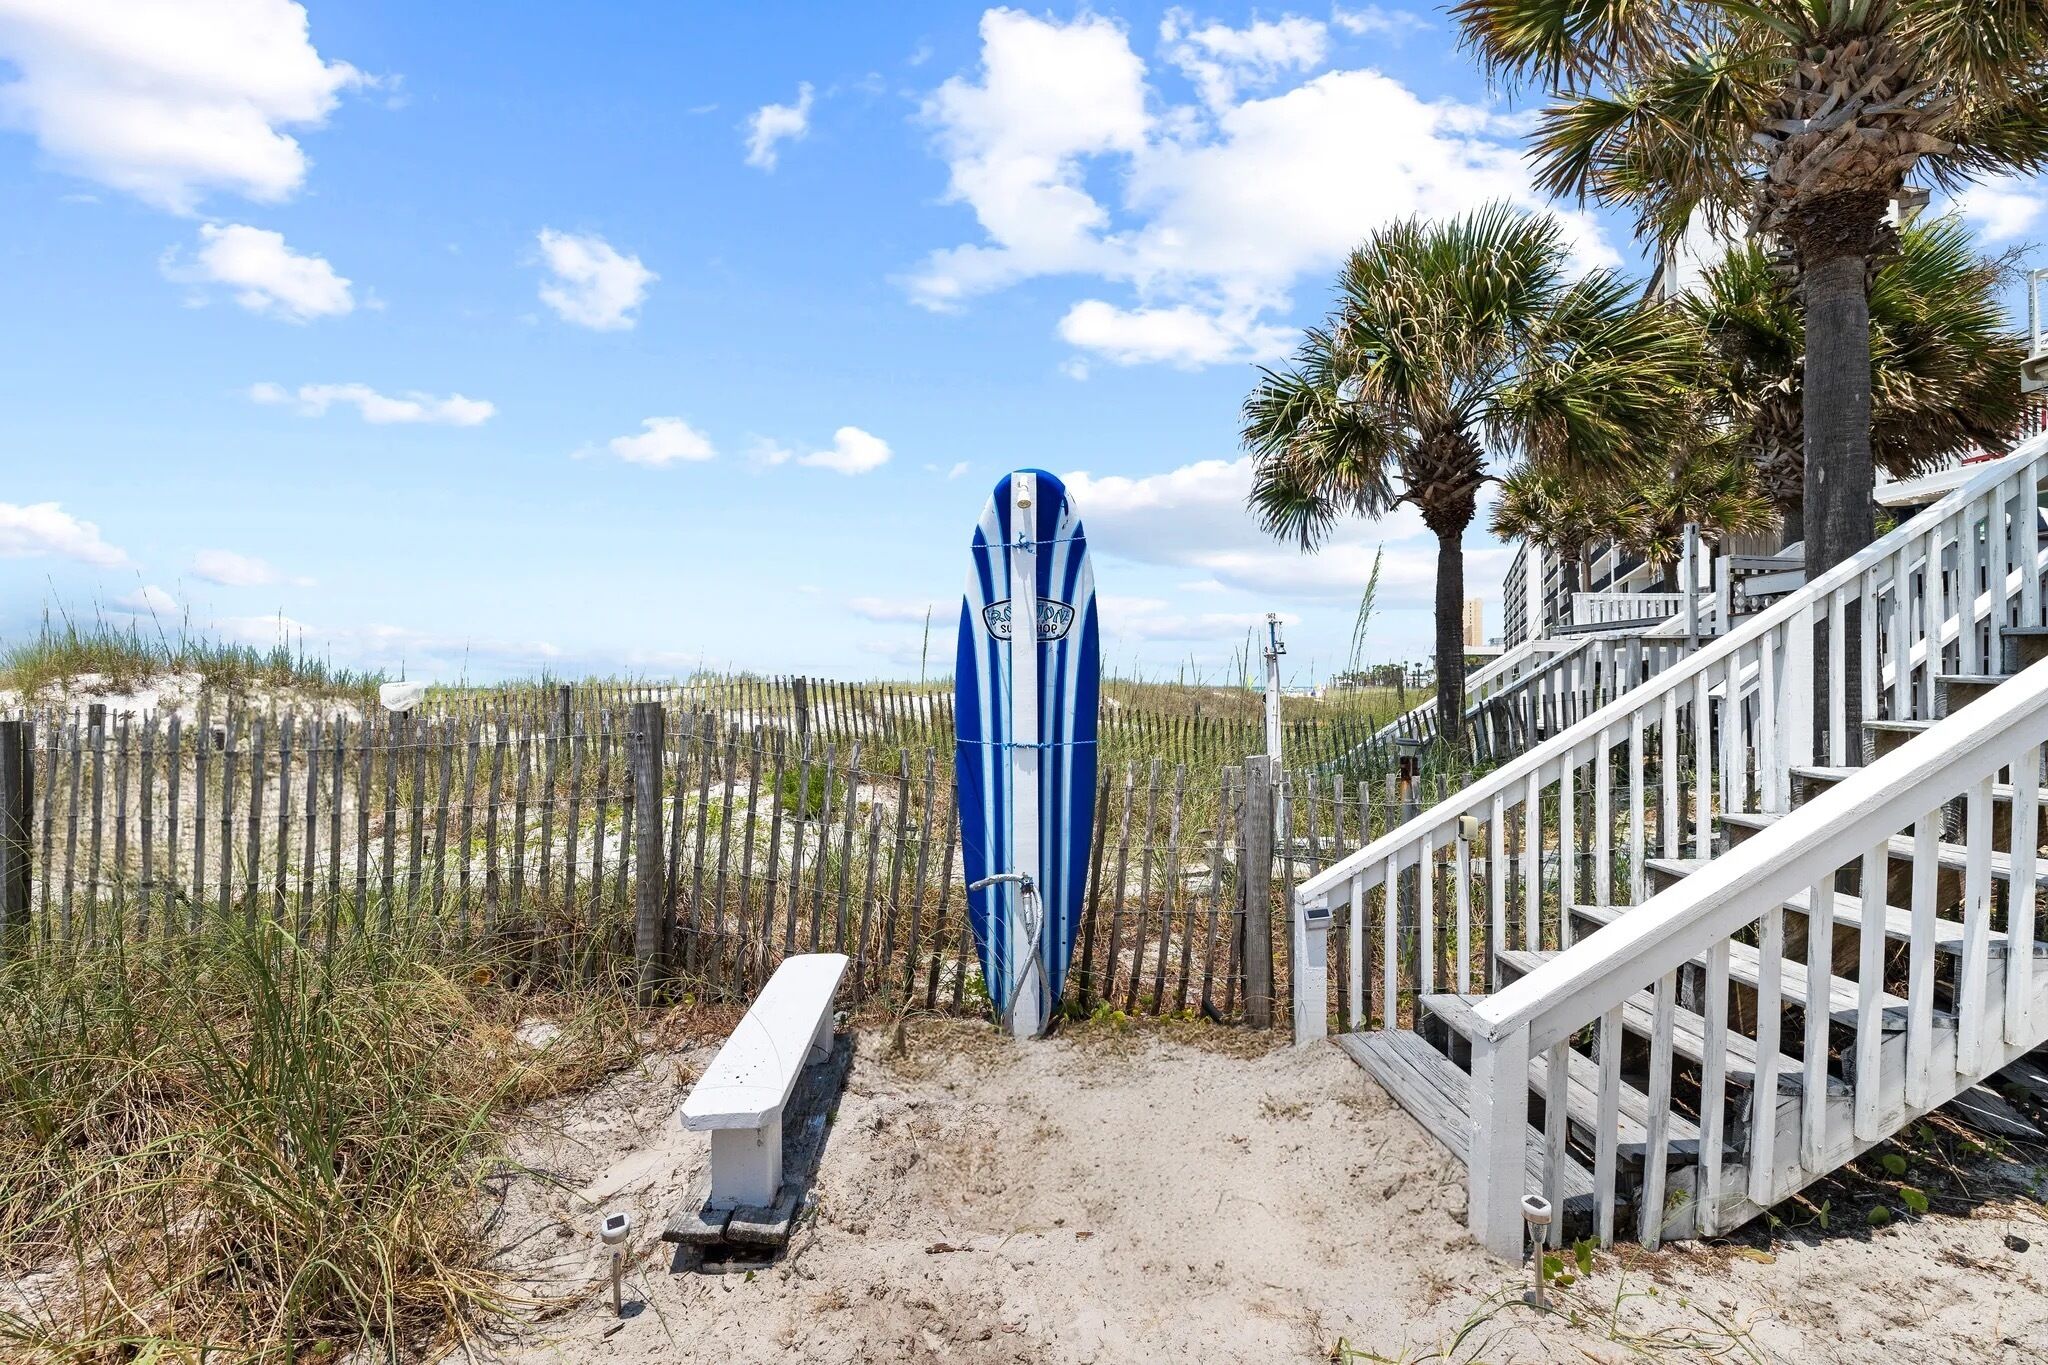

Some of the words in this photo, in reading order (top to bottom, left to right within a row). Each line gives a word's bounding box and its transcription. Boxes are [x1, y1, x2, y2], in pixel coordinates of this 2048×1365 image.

[989, 605, 1011, 625] RO
[1000, 624, 1011, 634] SU
[1037, 624, 1057, 634] HOP
